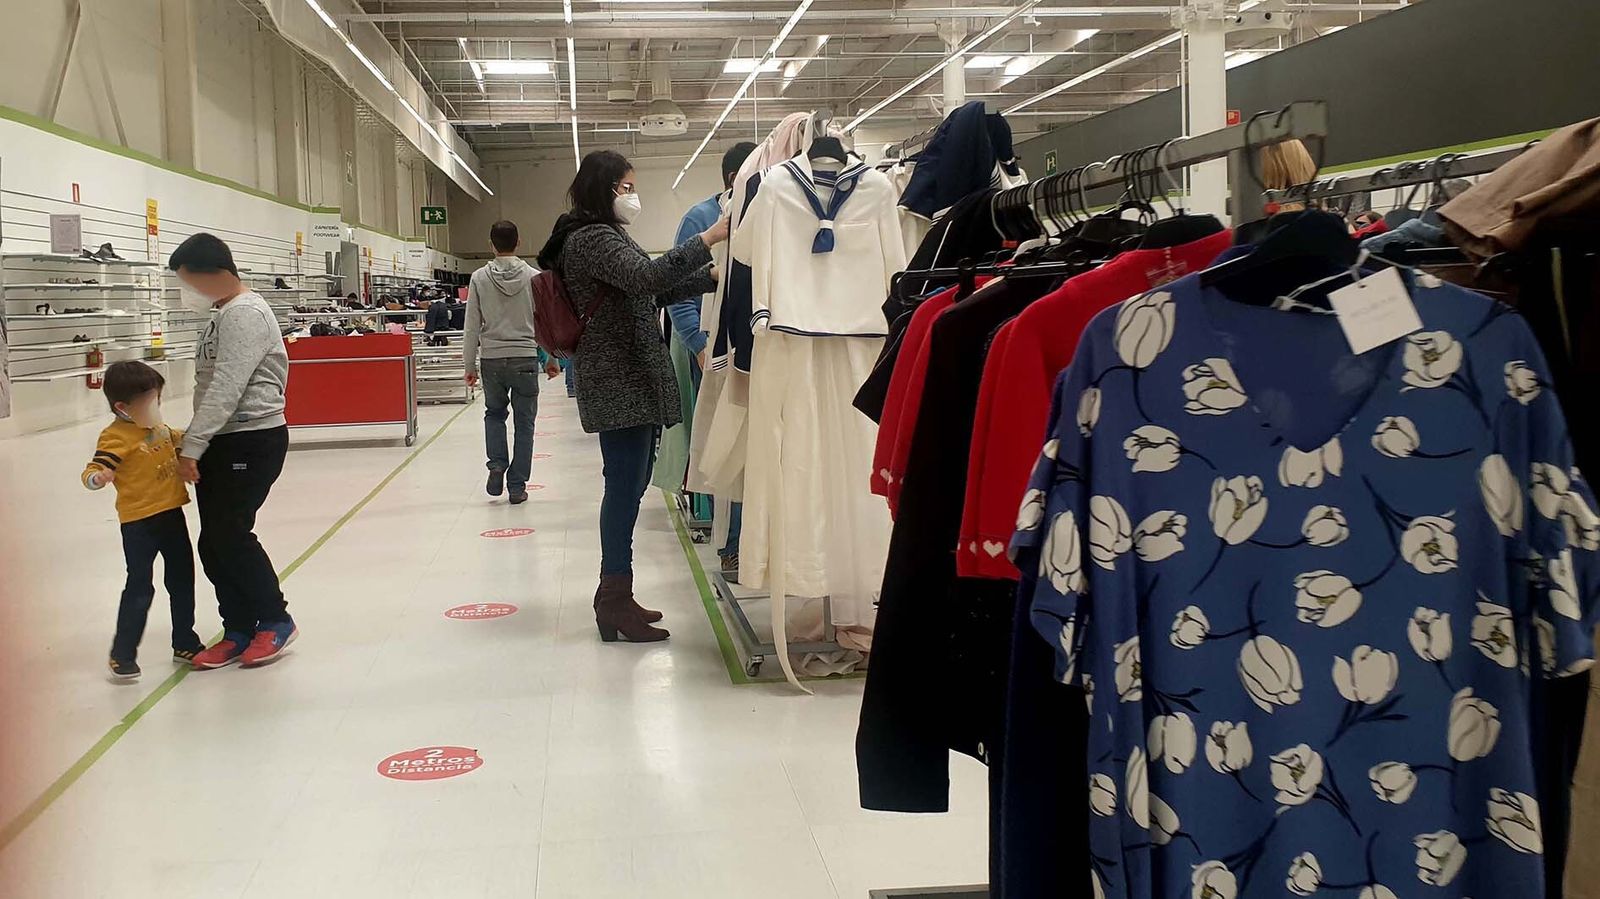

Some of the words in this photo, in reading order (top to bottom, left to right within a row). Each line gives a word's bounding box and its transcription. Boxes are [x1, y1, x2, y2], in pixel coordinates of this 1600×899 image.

[424, 749, 443, 758] 2
[389, 757, 475, 767] Metros
[387, 765, 472, 774] Distancia
